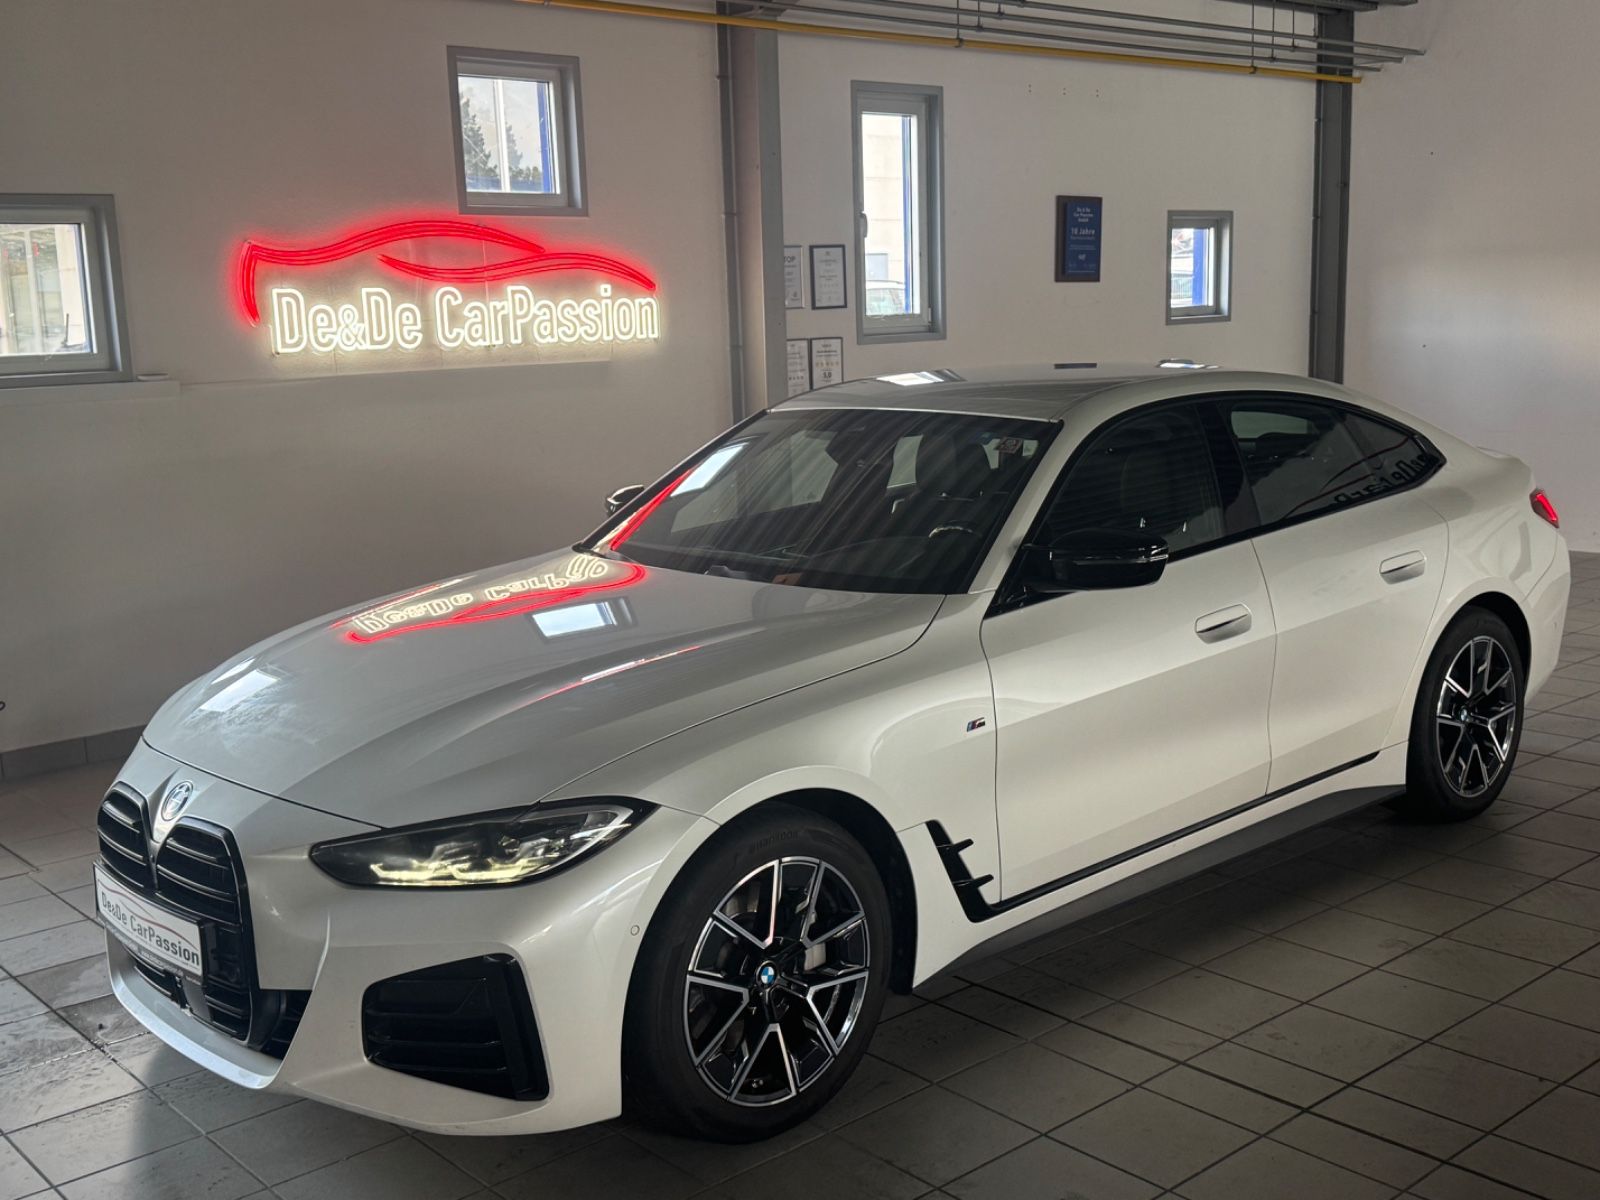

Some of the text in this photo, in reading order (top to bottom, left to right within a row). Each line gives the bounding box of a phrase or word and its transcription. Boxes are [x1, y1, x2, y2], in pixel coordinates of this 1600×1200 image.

[271, 283, 660, 354] De&De CarPassion
[129, 915, 200, 967] CarPassion
